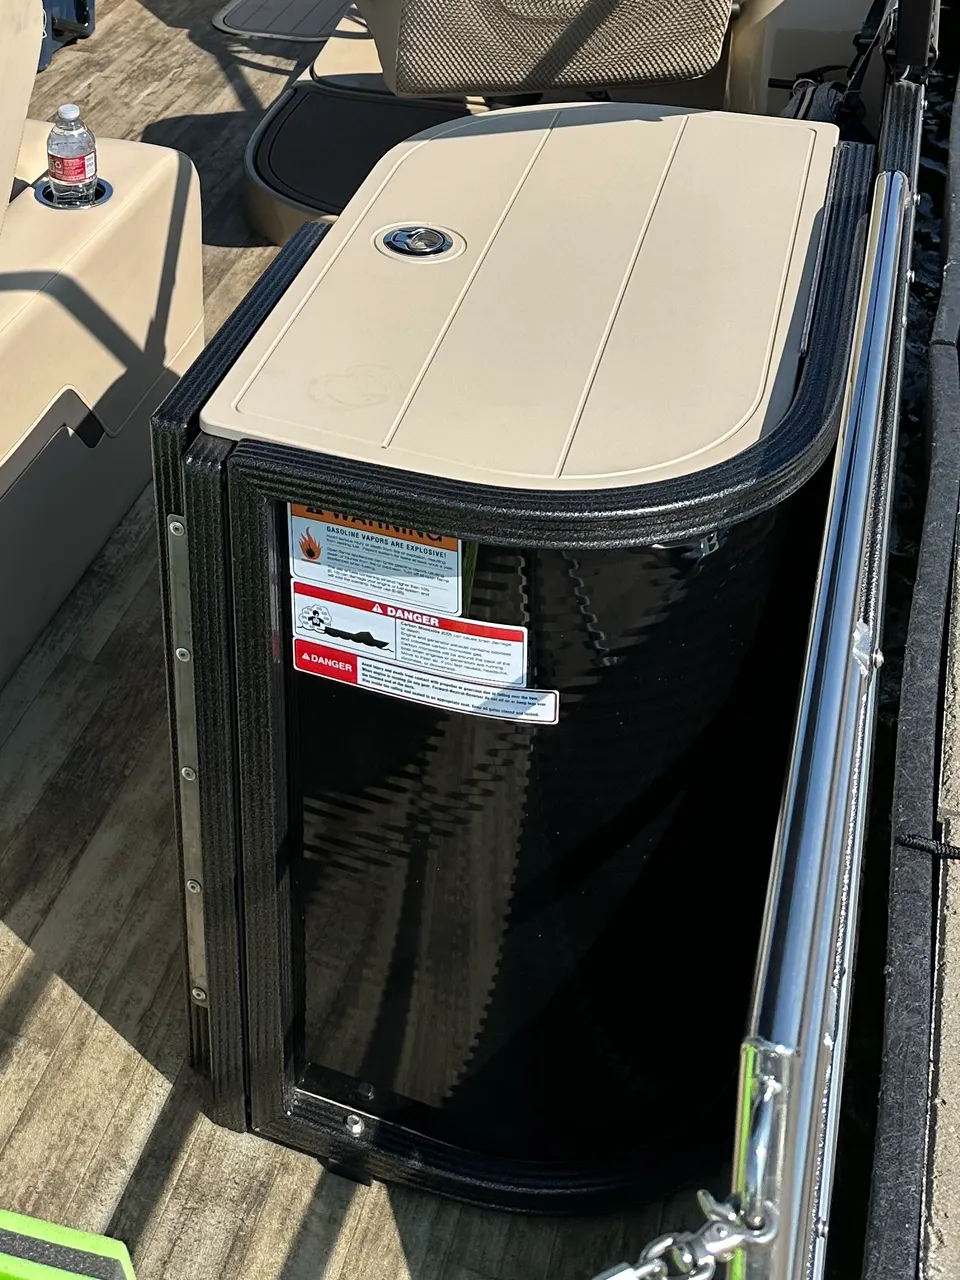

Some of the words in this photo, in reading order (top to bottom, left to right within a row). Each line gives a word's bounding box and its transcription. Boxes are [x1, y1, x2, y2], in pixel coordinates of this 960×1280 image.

[327, 525, 360, 539] GASOLINE
[362, 533, 388, 546] VAPORS
[391, 540, 404, 549] ARE
[406, 544, 447, 559] EXPLOSIVE!
[387, 607, 439, 626] DANGER
[311, 655, 352, 672] DANGER
